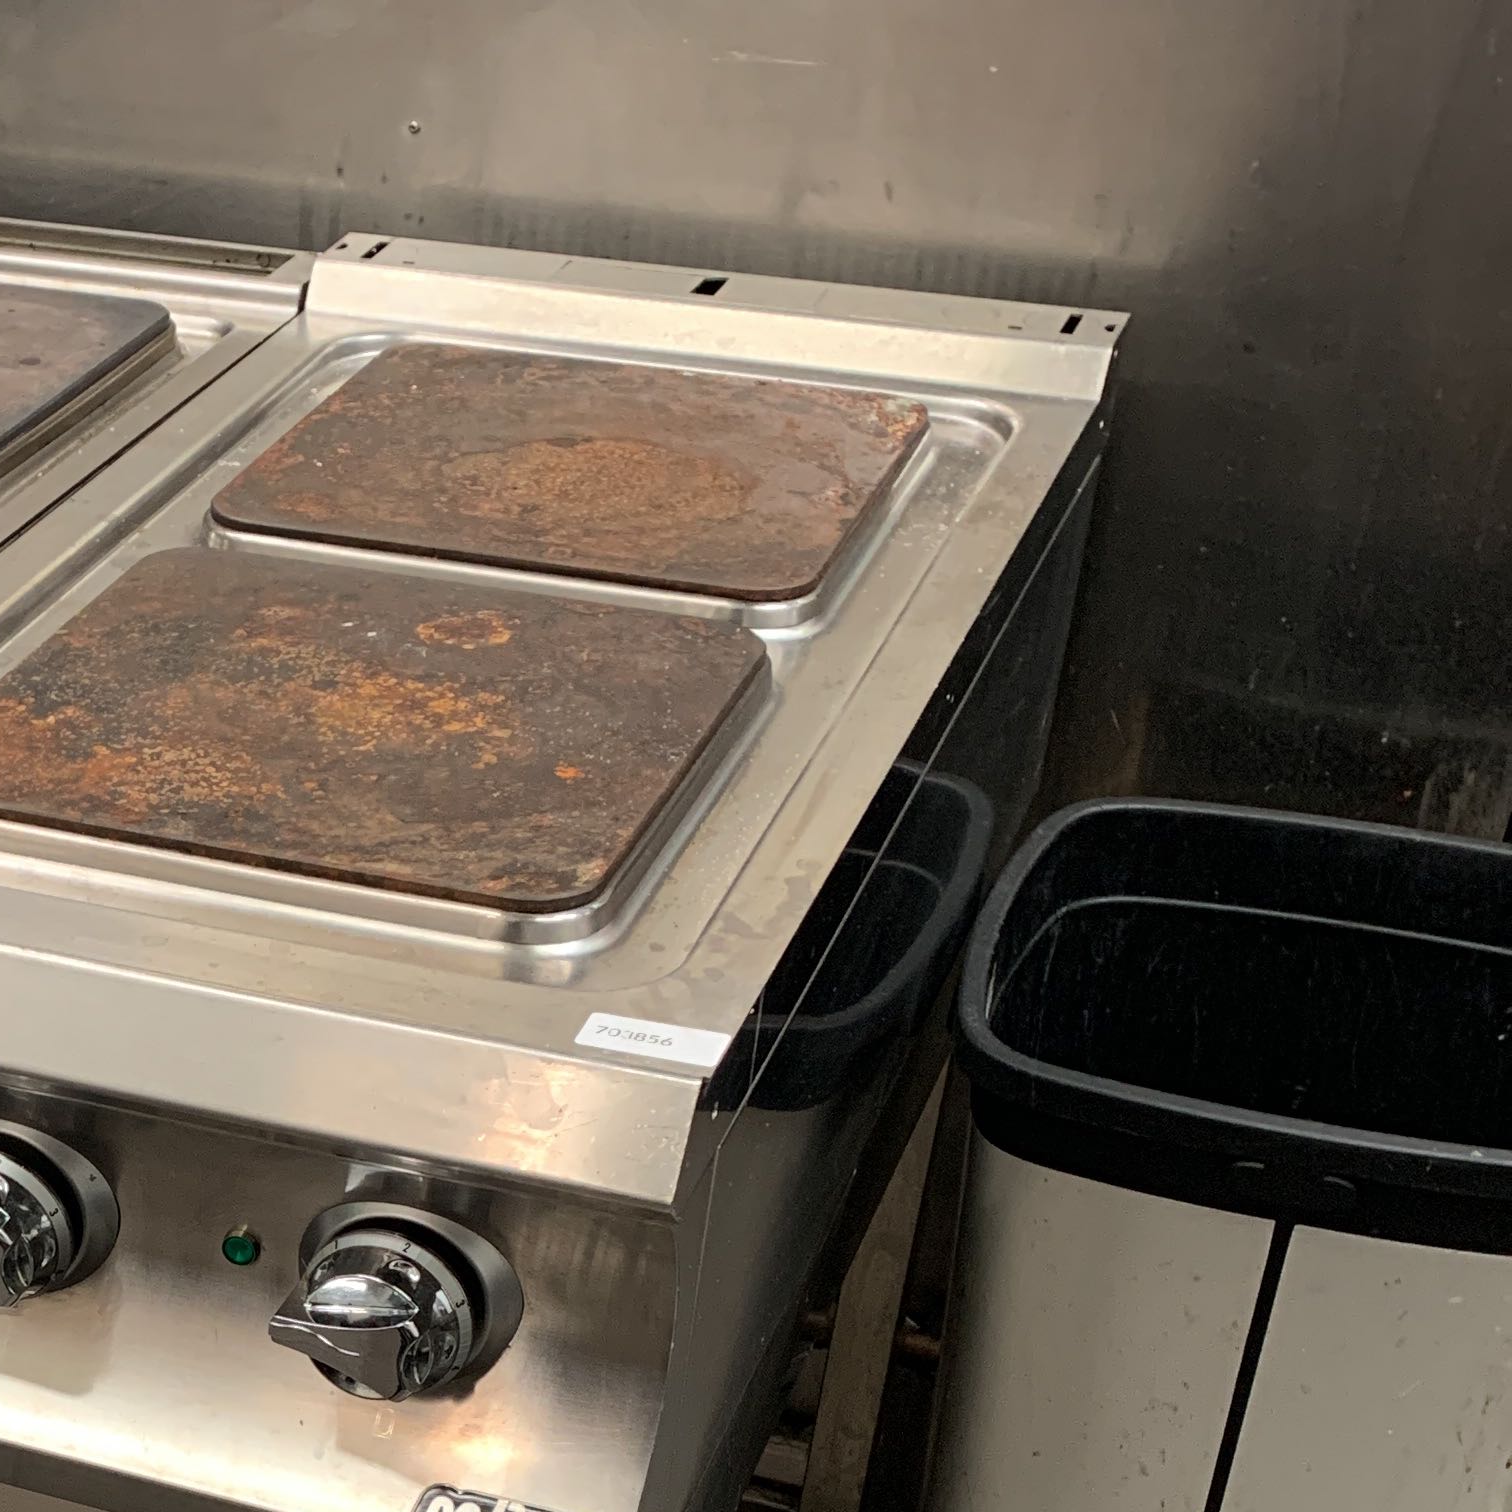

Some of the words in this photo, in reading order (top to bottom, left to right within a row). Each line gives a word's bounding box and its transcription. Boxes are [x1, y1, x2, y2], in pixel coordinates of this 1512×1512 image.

[595, 1025, 673, 1047] 703856
[49, 1207, 59, 1217] 3
[402, 1242, 412, 1254] 2
[456, 1299, 465, 1308] 3
